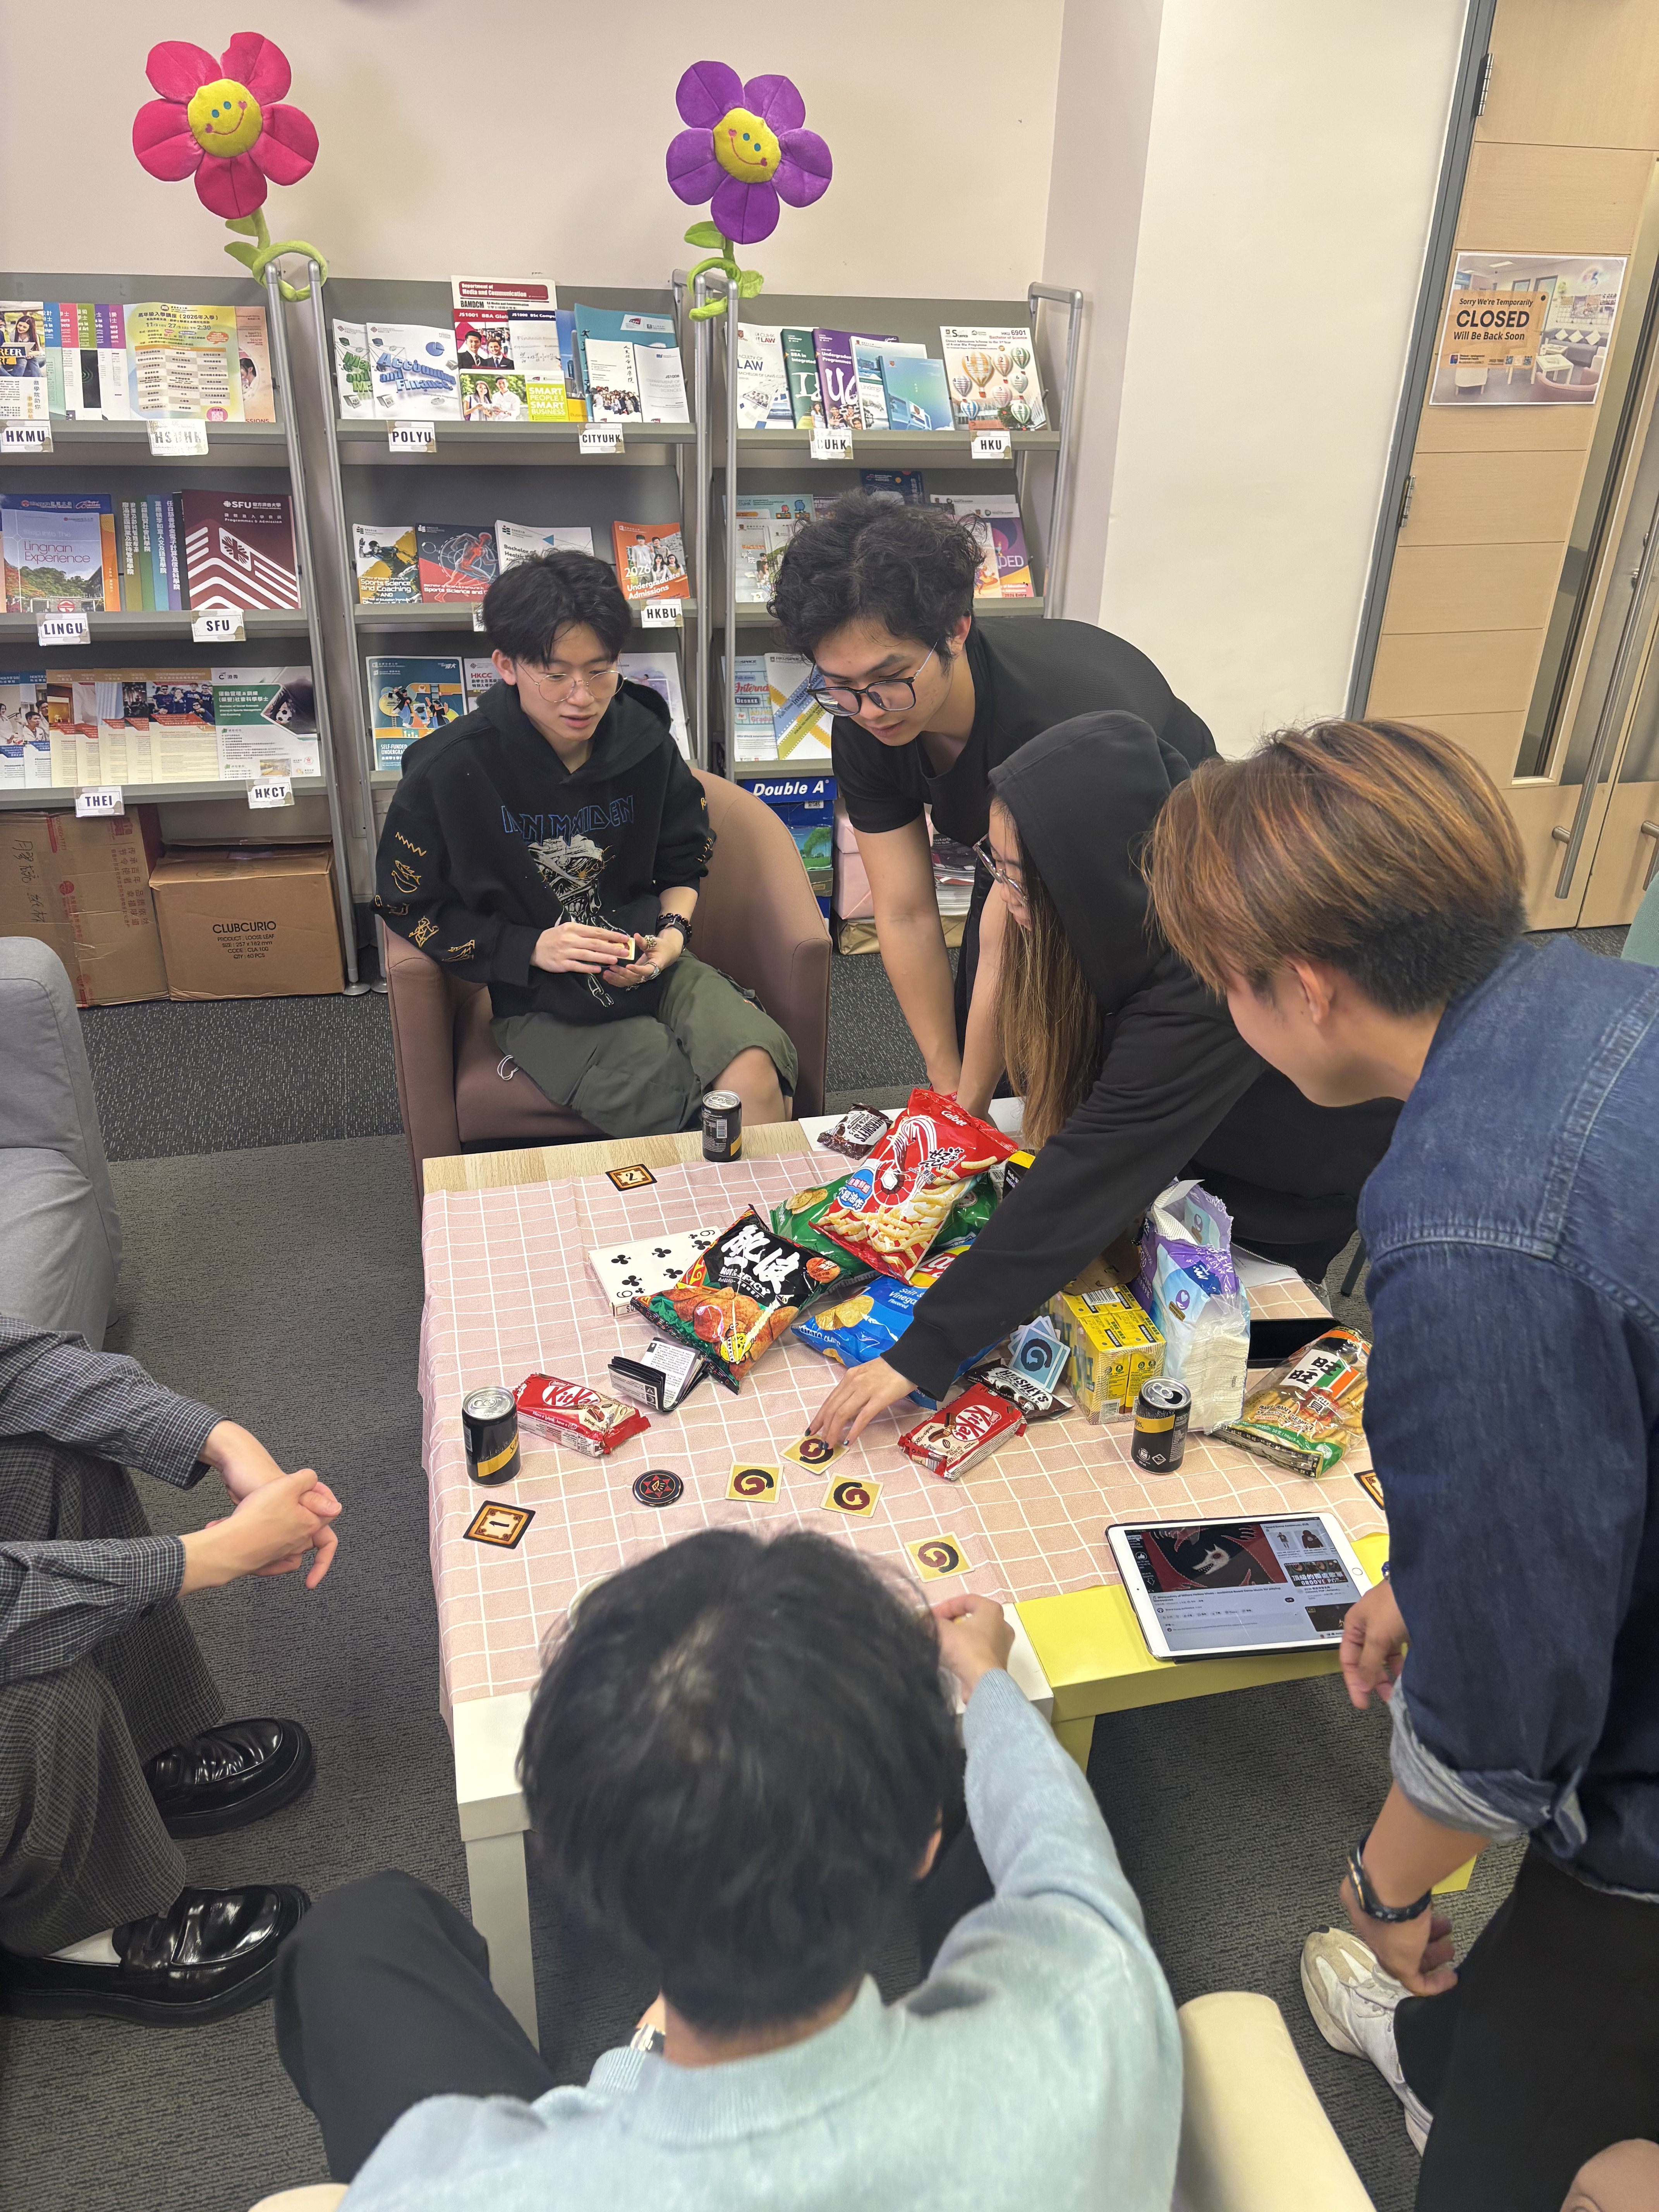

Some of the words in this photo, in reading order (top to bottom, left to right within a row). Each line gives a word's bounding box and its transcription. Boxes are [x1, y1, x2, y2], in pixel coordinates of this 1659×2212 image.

[1496, 299, 1534, 307] Temporarily
[1456, 310, 1530, 328] CLOSED
[1454, 331, 1469, 340] Will
[1504, 332, 1525, 340] Soon
[376, 352, 456, 385] Accounting
[737, 359, 763, 371] LAW
[380, 369, 404, 383] and
[6, 430, 45, 442] HKMU
[392, 432, 431, 443] POLYU
[582, 434, 621, 443] CITYUHK
[981, 440, 1001, 450] HKU
[24, 541, 72, 555] Lingnan
[504, 544, 529, 554] Bachelor
[25, 551, 90, 564] Experience
[624, 564, 651, 578] 2026
[627, 572, 680, 592] Undergraduate
[628, 585, 669, 599] Admissions
[647, 608, 677, 618] HKBU
[44, 623, 83, 635] LINGU
[206, 620, 229, 632] SFU
[255, 787, 285, 799] HKCT
[753, 782, 808, 797] Double
[812, 780, 824, 793] A
[85, 796, 112, 806] THEI
[548, 795, 634, 847] MAIDEN
[213, 921, 276, 933] CLUBCURIO
[941, 1110, 967, 1127] Calbee
[854, 1116, 884, 1142] HERSHEY'S
[625, 1172, 638, 1182] 2
[889, 1291, 917, 1305] Vinega
[900, 1287, 915, 1297] Salt
[1288, 1356, 1342, 1385] 旺旺
[999, 1370, 1049, 1403] HERSHEY'S
[544, 1384, 599, 1406] KitKat
[955, 1406, 993, 1441] KitKat
[488, 1520, 510, 1528] 1
[1301, 1578, 1325, 1586] GROOVE
